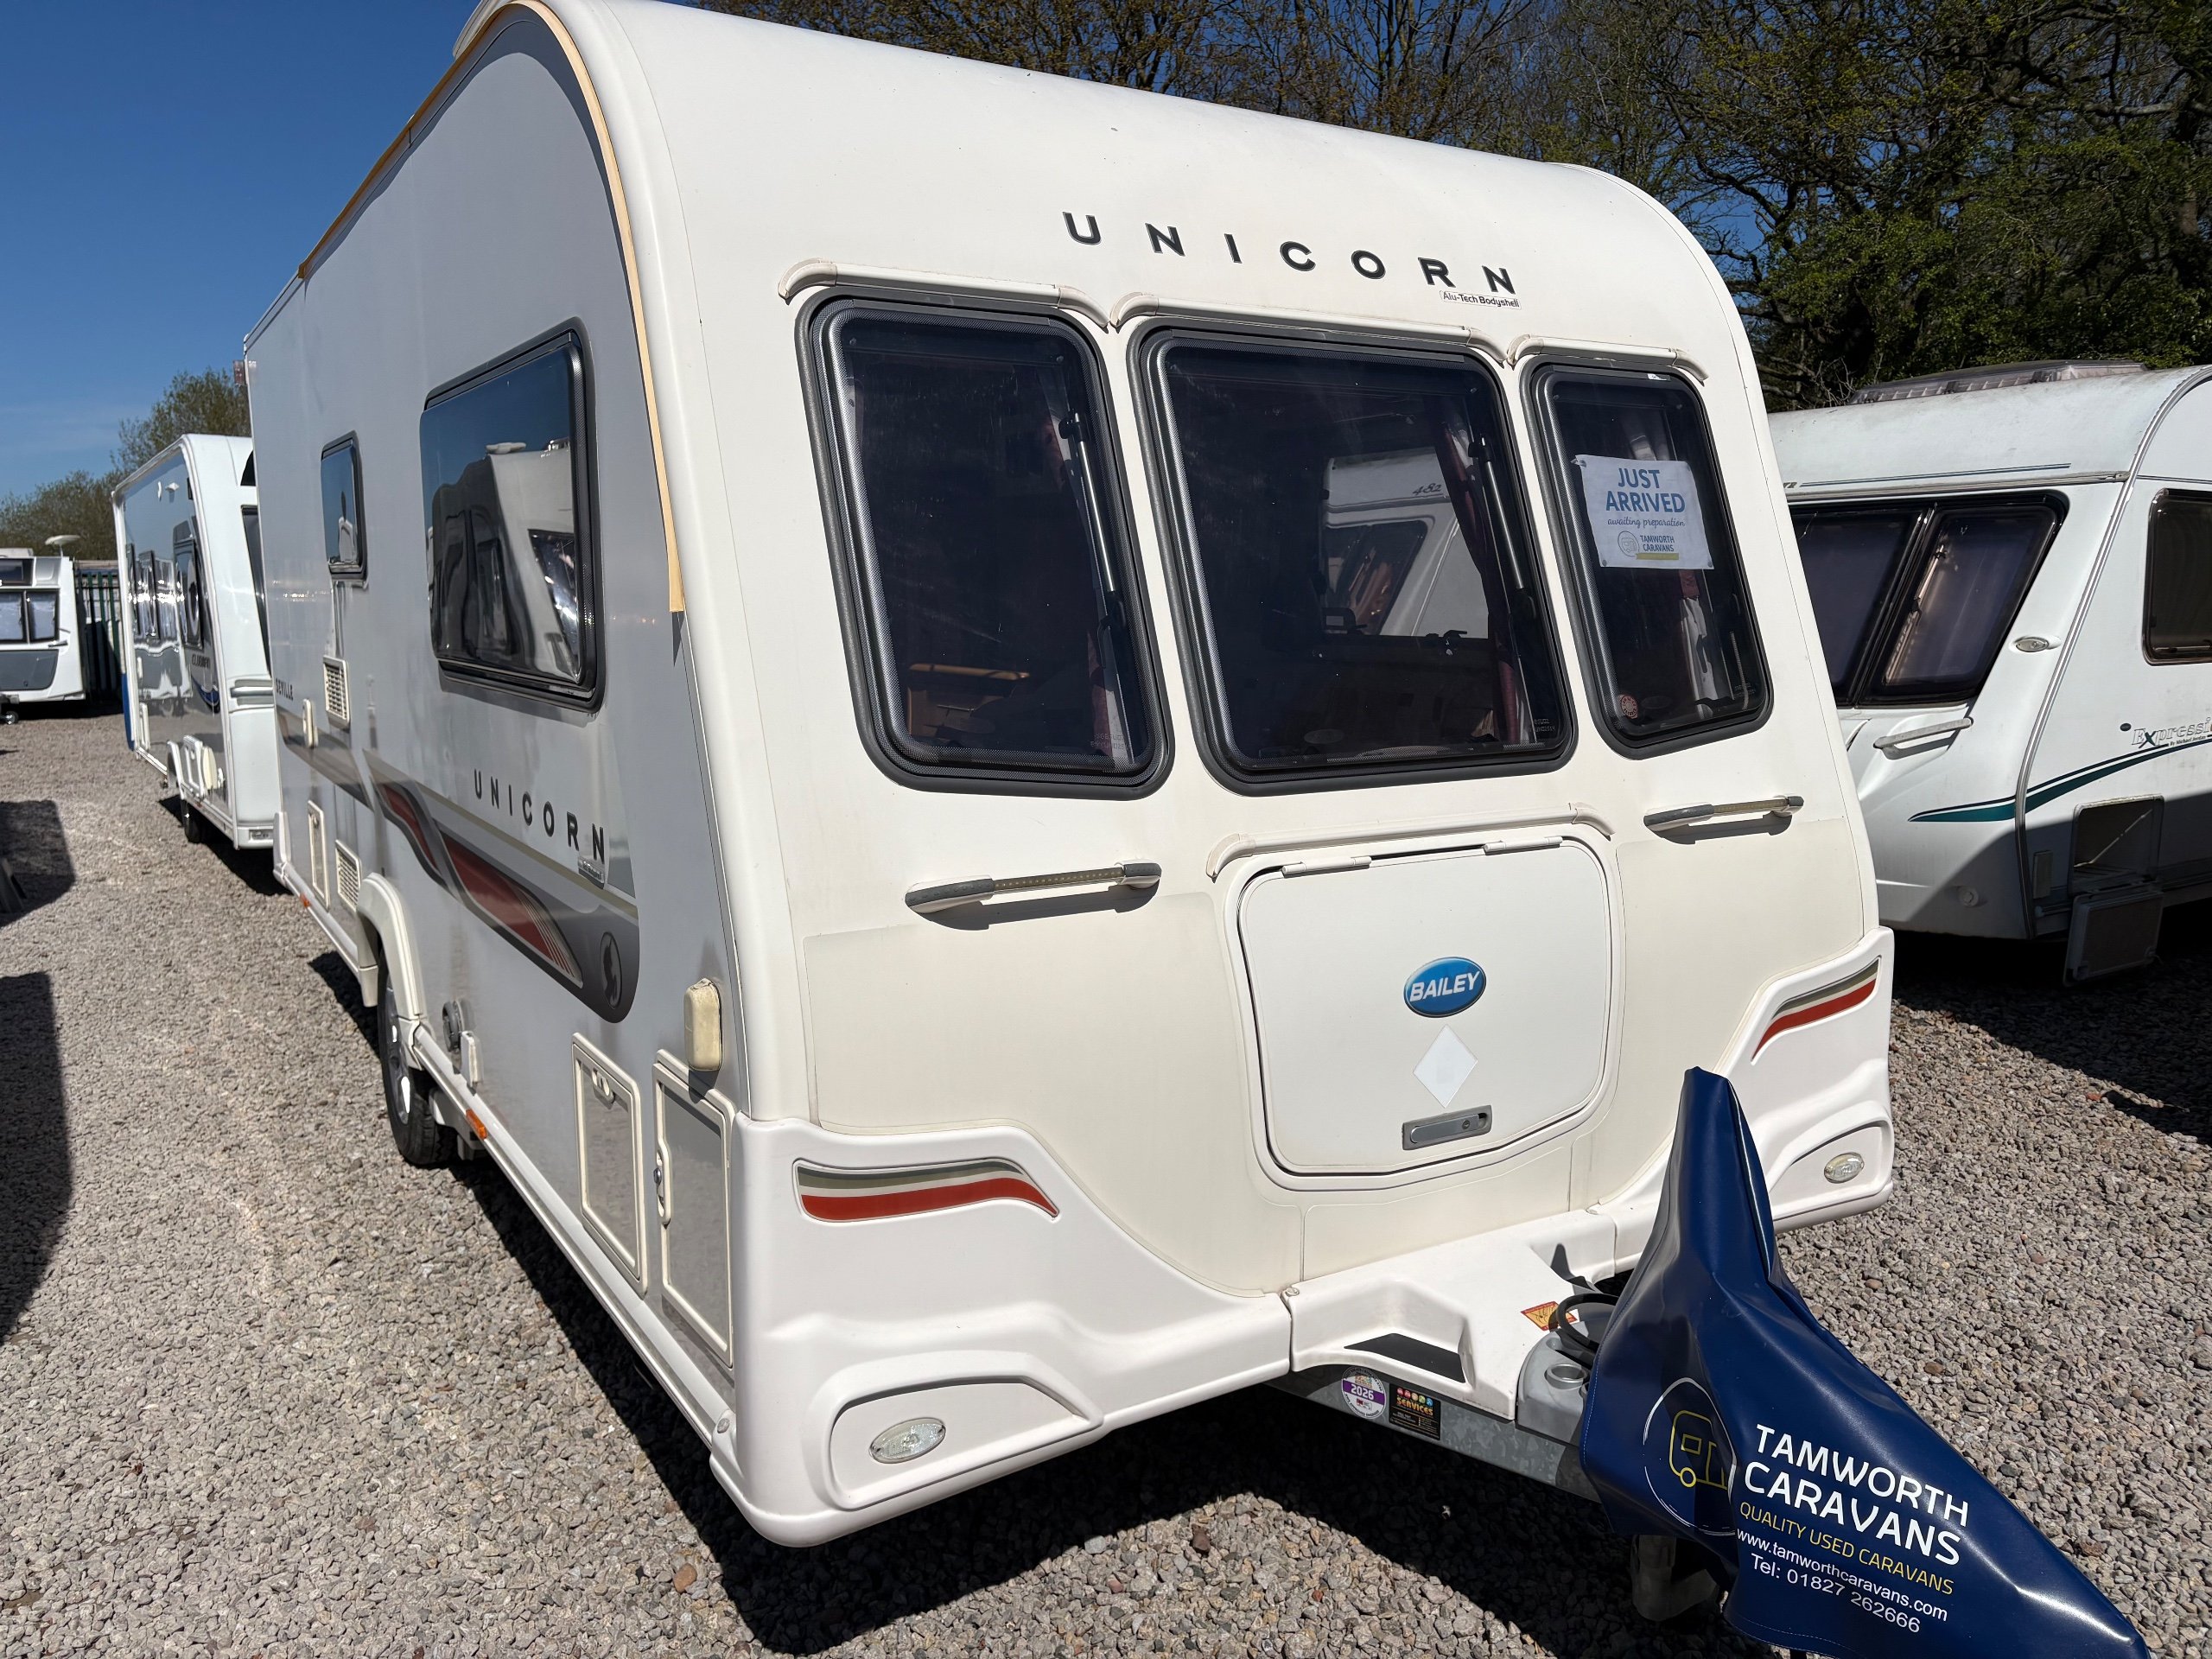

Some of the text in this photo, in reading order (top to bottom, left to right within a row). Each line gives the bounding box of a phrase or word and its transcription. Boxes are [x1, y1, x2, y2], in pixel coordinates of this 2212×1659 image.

[1062, 211, 1516, 295] UNICORN
[1443, 291, 1519, 308] Alu-Tech Bodyshell
[1412, 482, 1442, 496] 482
[1618, 467, 1661, 489] JUST
[1605, 490, 1685, 512] ARRIVED
[1607, 516, 1686, 529] awaiting preparation
[1640, 535, 1675, 543] TAMWORTH
[1643, 543, 1675, 552] CARAVANS
[2131, 716, 2212, 749] Expressi
[474, 768, 605, 863] UNICORN
[1409, 971, 1480, 1002] BAILEY
[1351, 1383, 1375, 1401] 2026
[1757, 1424, 1968, 1527] TAMWORTH
[1745, 1461, 1961, 1566] CARAVANS
[1739, 1501, 1955, 1595] QUALITY USED CARAVANS
[1737, 1528, 1948, 1622] www.tamworthcaravans.com
[1751, 1553, 1921, 1634] Tel: 01827 262666
